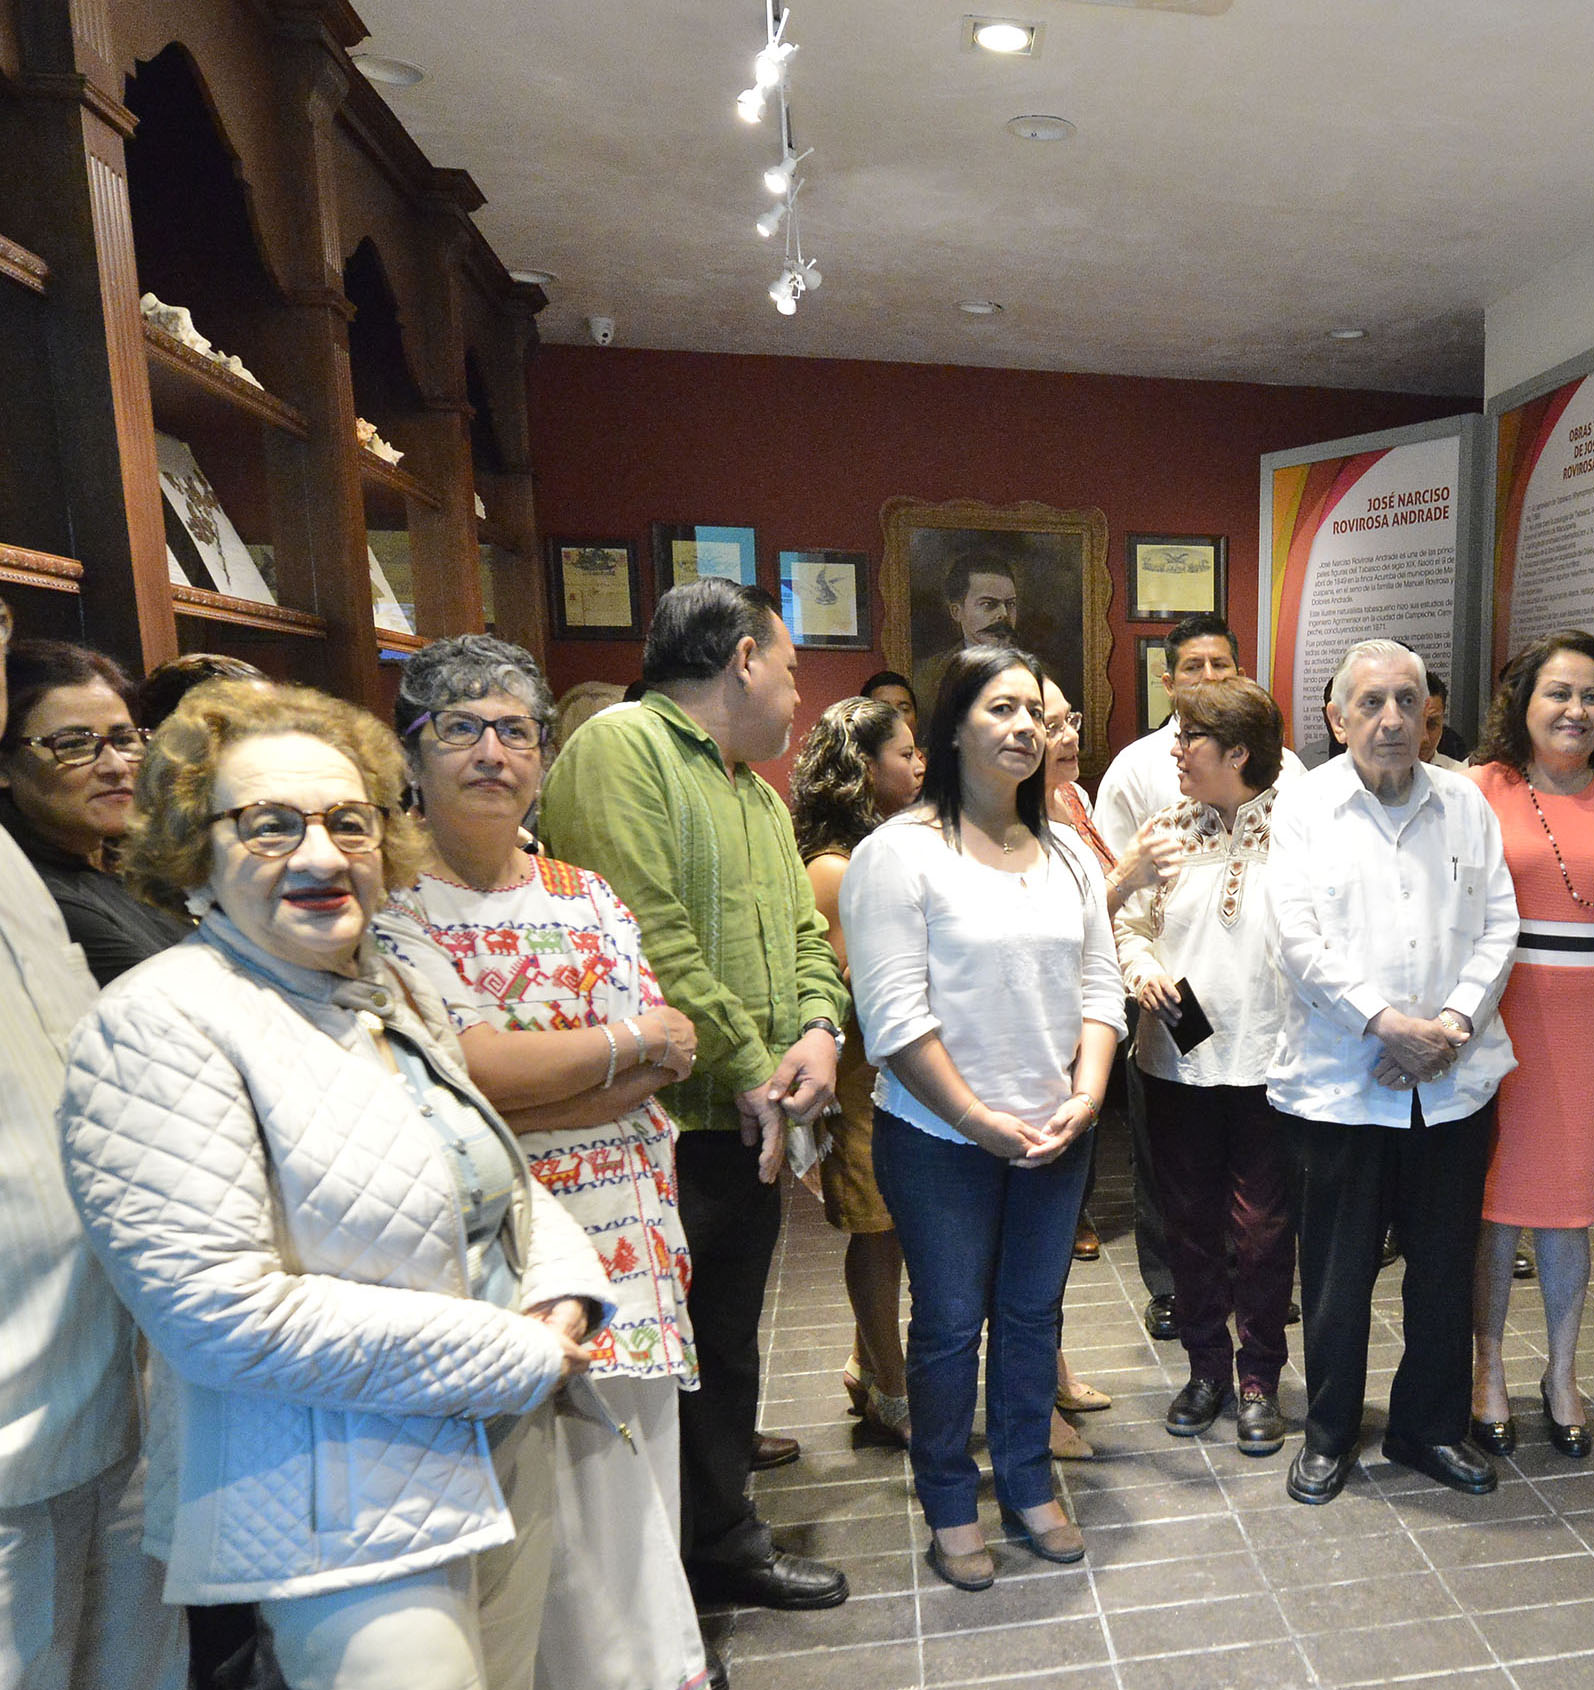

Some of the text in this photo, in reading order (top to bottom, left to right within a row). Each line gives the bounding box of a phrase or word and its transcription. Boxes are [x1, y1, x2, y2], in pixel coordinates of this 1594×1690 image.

[1568, 422, 1592, 442] OBRAS
[1574, 444, 1583, 459] DE
[1367, 486, 1451, 513] JOSÉ NARCISO
[1332, 505, 1450, 535] ROVIROSA ANDRADE
[1375, 554, 1398, 562] Andrade
